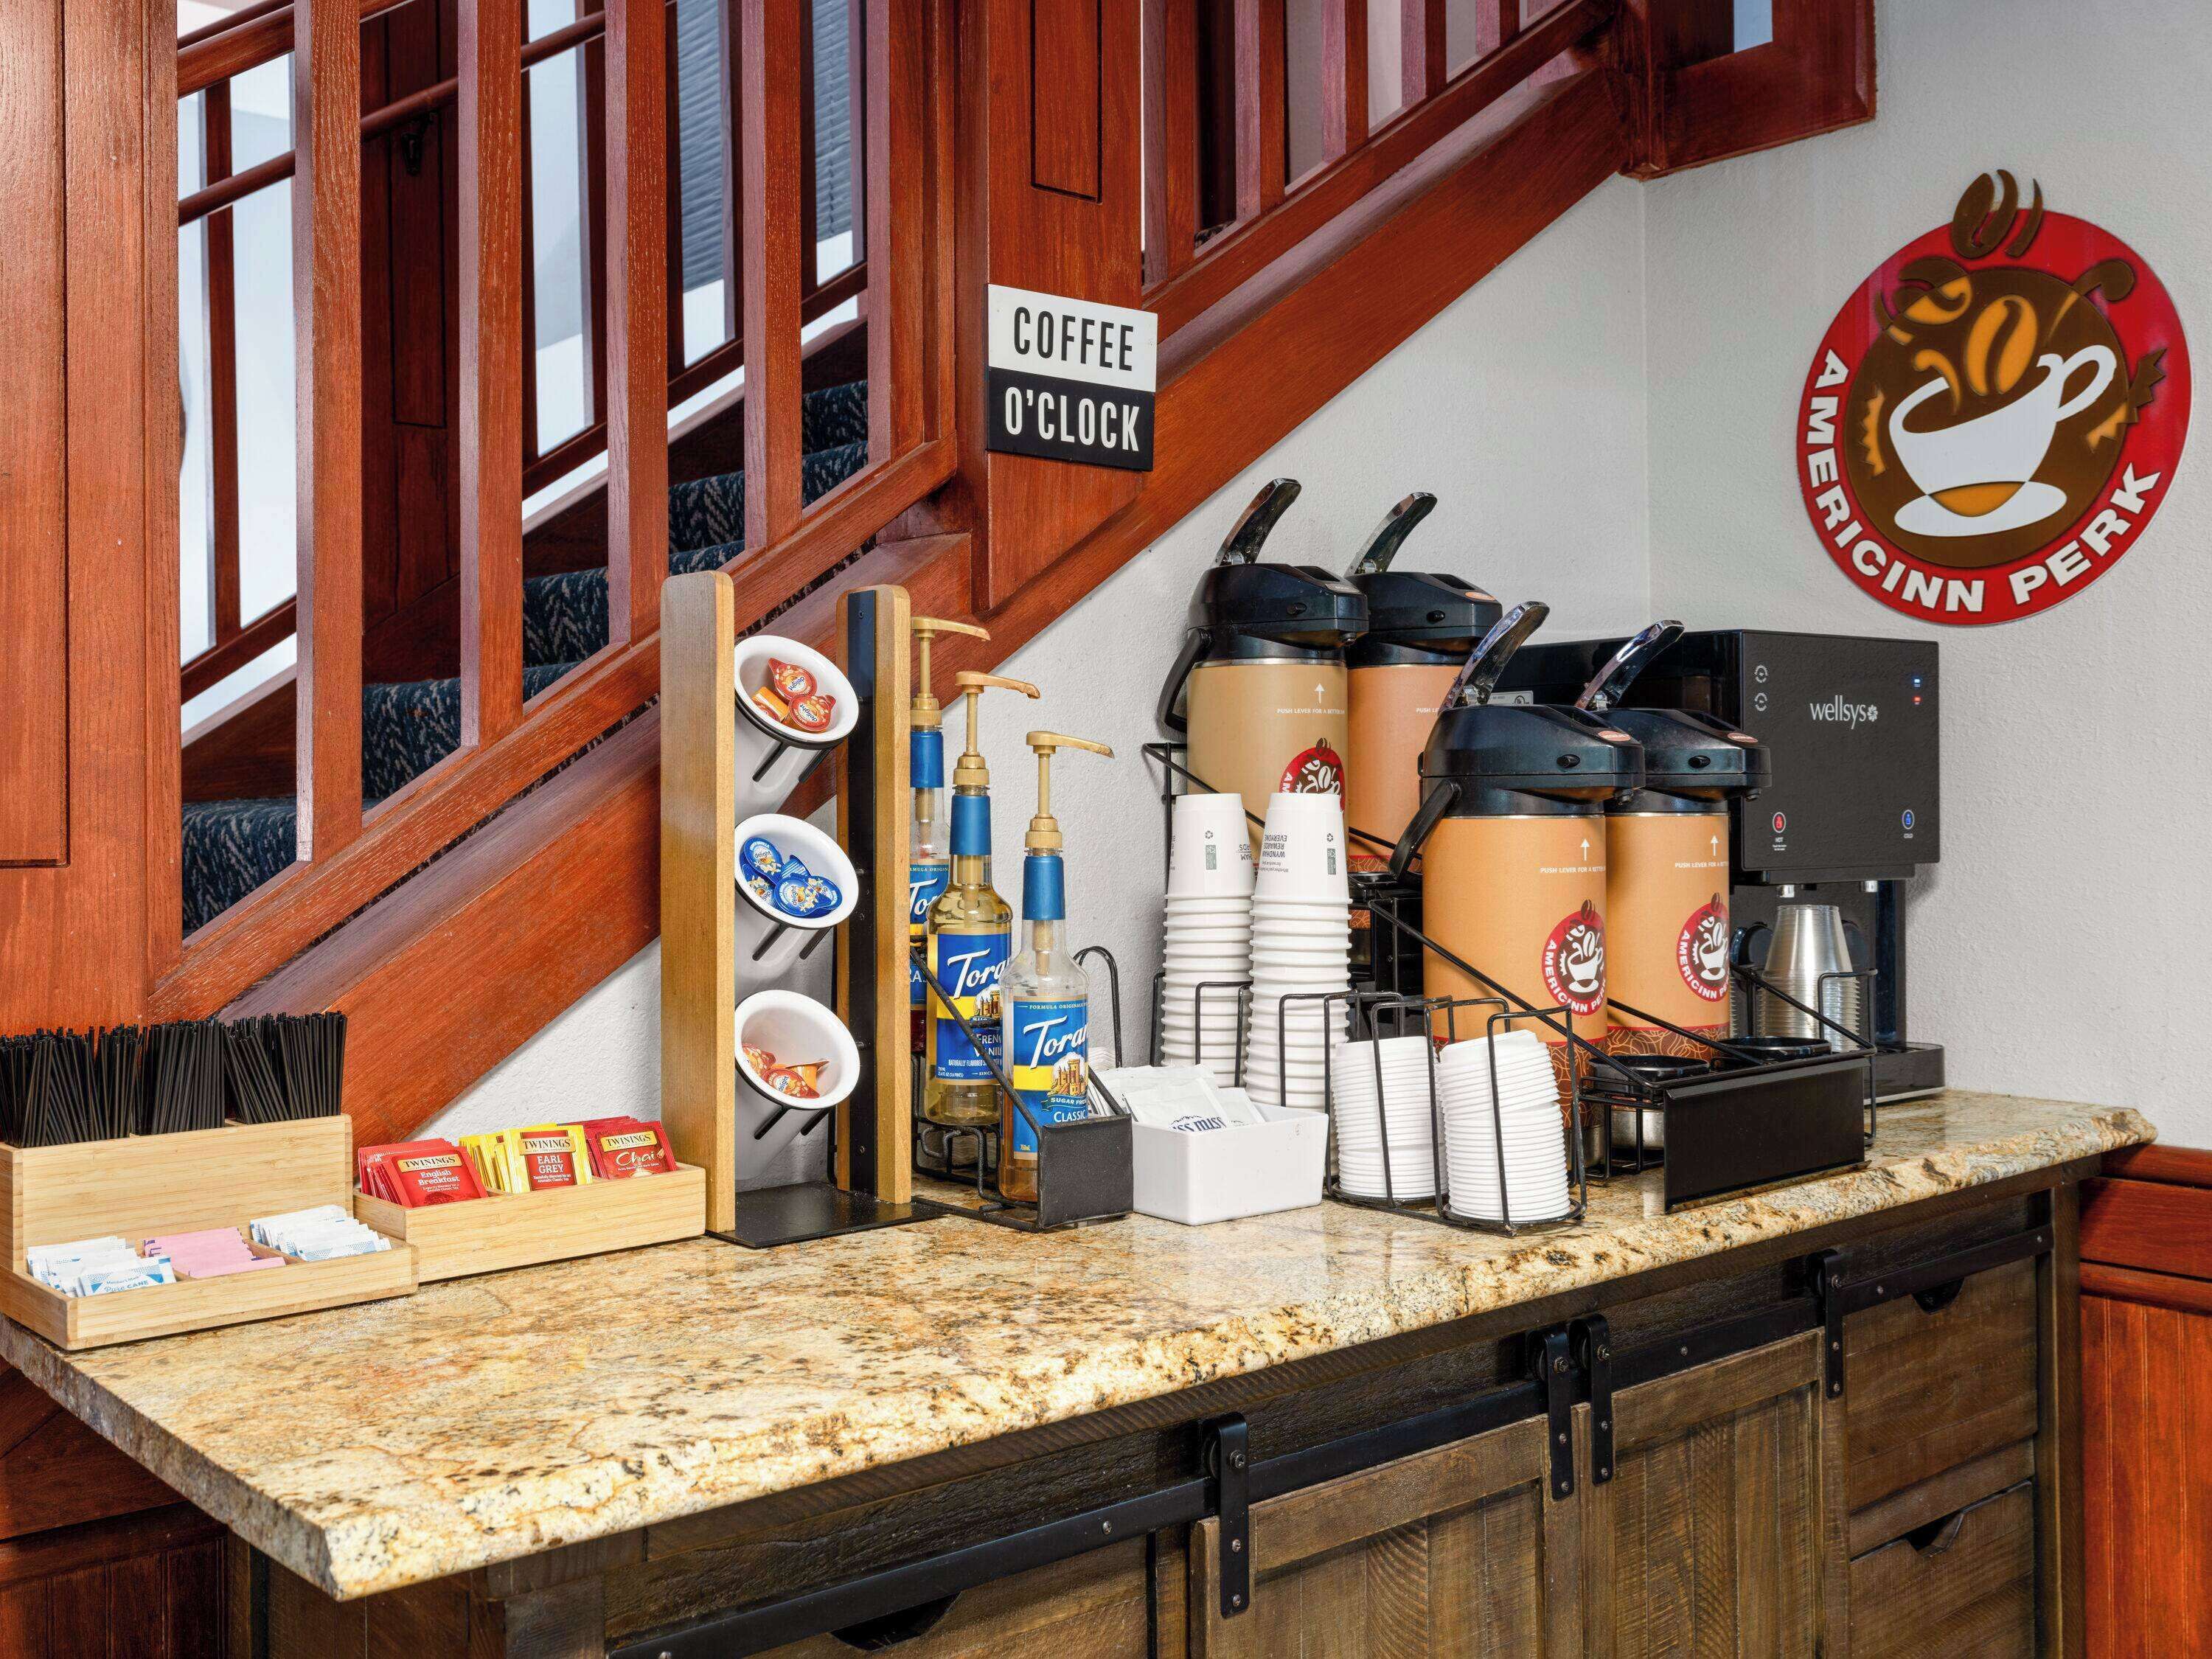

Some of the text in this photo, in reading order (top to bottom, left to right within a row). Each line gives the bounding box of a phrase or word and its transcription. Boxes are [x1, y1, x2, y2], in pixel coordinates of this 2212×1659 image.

[1014, 306, 1134, 372] COFFEE
[1004, 386, 1140, 452] O'CLOCK
[1806, 348, 2162, 613] AMERICINN PERK
[787, 676, 805, 692] delight
[799, 703, 818, 723] delight
[1809, 695, 1867, 730] wellsys
[754, 850, 772, 859] delight
[1679, 929, 1717, 999] AMERICINN
[947, 947, 1010, 1001] Tora
[1054, 1109, 1086, 1123] CLASSIC
[522, 1139, 571, 1150] TWININGS
[606, 1134, 651, 1147] TWININGS
[403, 1156, 456, 1168] TWININGS
[537, 1155, 563, 1164] EARL
[616, 1151, 655, 1166] Chai
[420, 1169, 452, 1178] English
[538, 1164, 564, 1174] GREY
[417, 1175, 460, 1186] Breakfast
[127, 1280, 149, 1289] CANE
